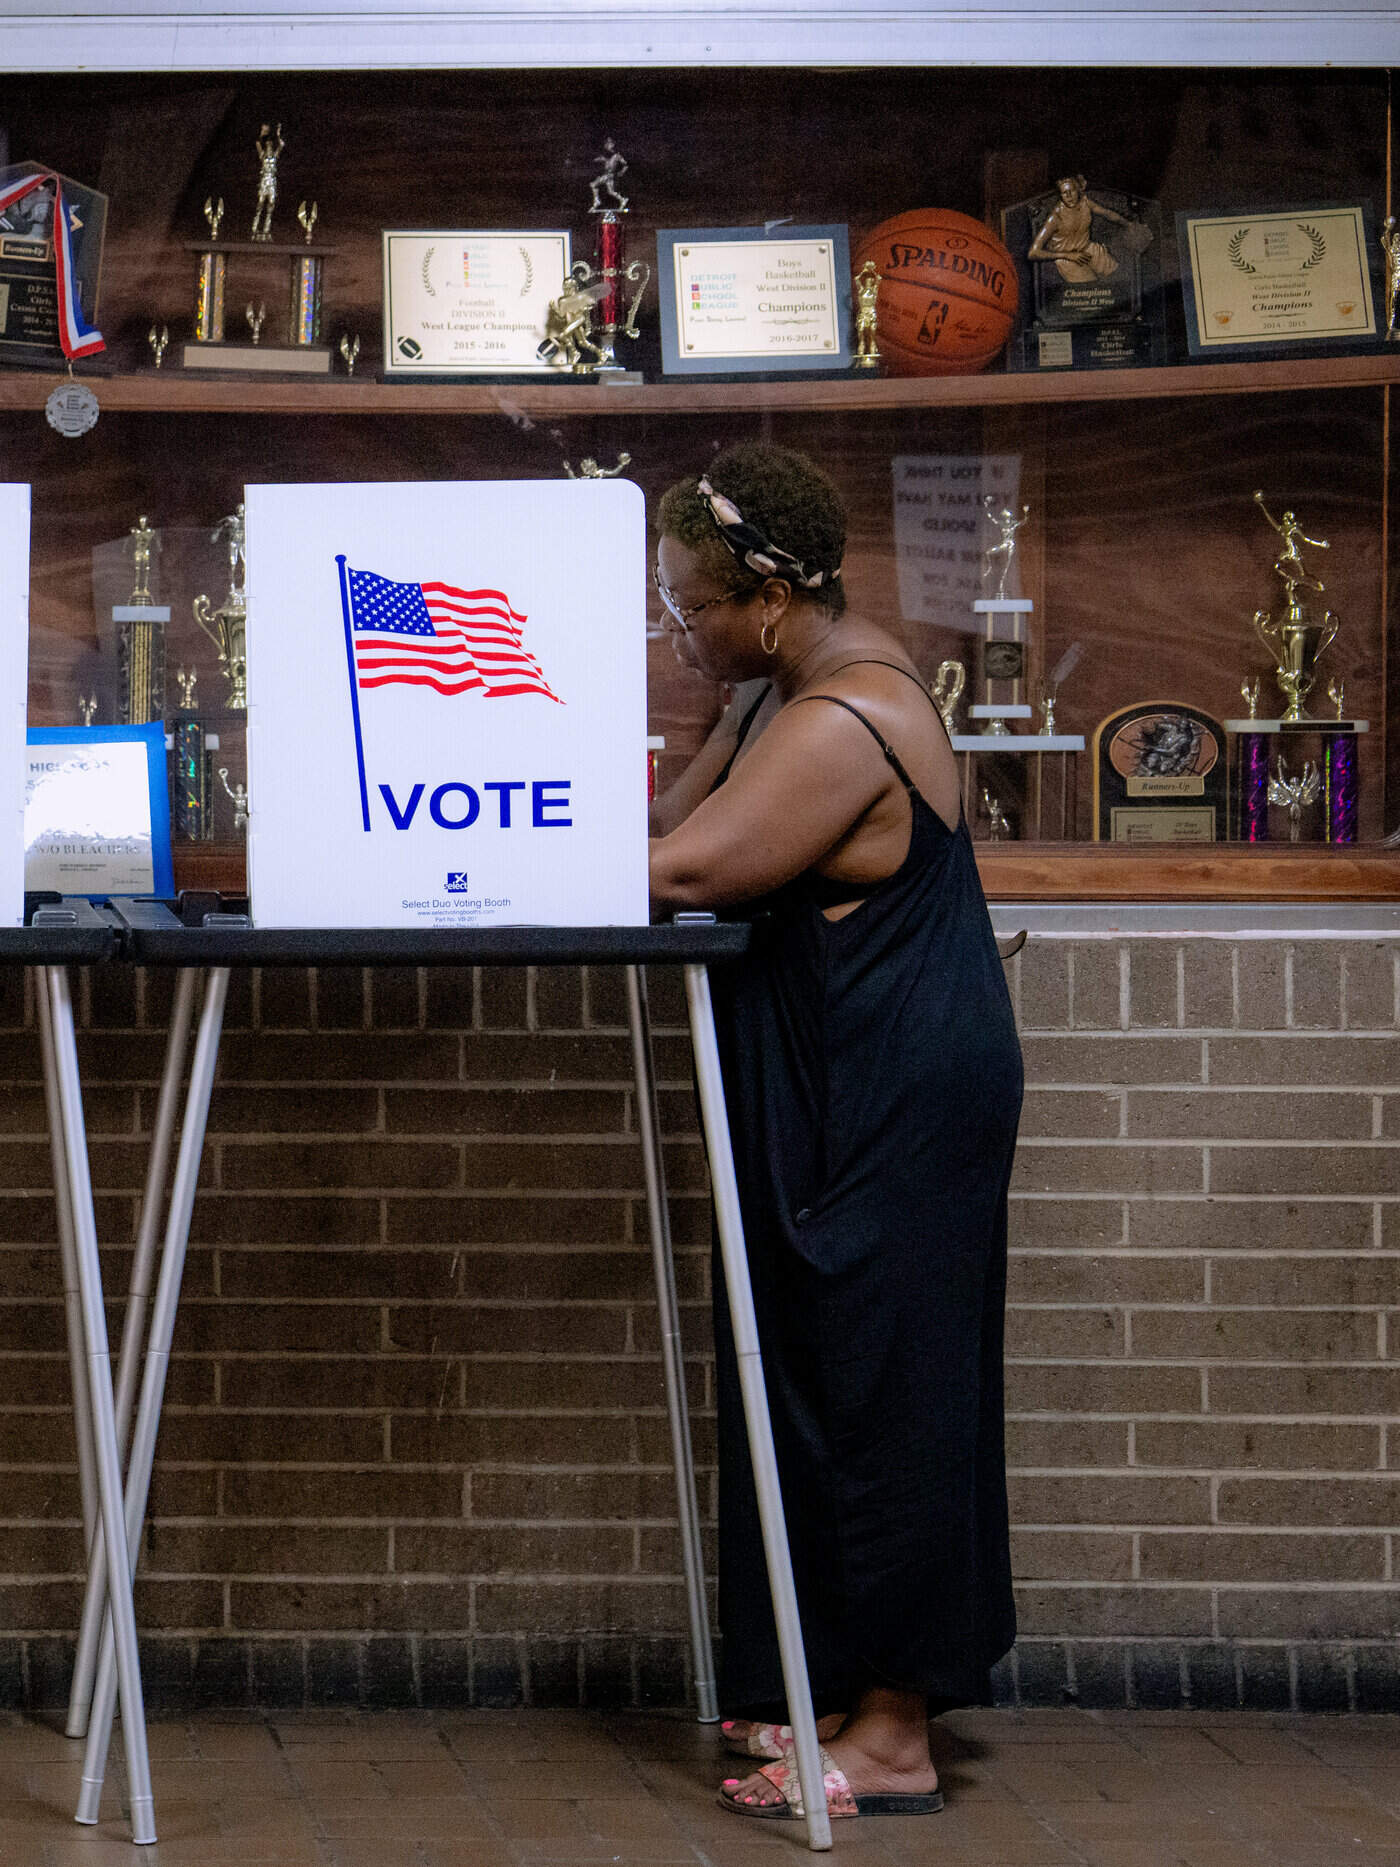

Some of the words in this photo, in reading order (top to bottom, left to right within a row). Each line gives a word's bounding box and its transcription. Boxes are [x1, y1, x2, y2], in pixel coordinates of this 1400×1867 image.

[777, 258, 803, 269] Boys
[764, 270, 817, 280] Basketball
[886, 243, 1006, 299] SPALDING
[756, 283, 780, 293] West
[781, 283, 818, 292] Division
[757, 301, 827, 315] Champions
[1252, 301, 1313, 312] Champions
[421, 321, 445, 331] West
[447, 321, 481, 332] League
[483, 321, 537, 333] Champions
[768, 333, 820, 344] 2016-2017
[453, 341, 475, 350] 2015
[484, 341, 507, 350] 2016
[377, 780, 573, 831] VOTE
[443, 881, 468, 891] select
[401, 899, 430, 909] Select
[432, 899, 451, 908] Duo
[453, 898, 482, 910] Voting
[484, 897, 511, 907] Booth
